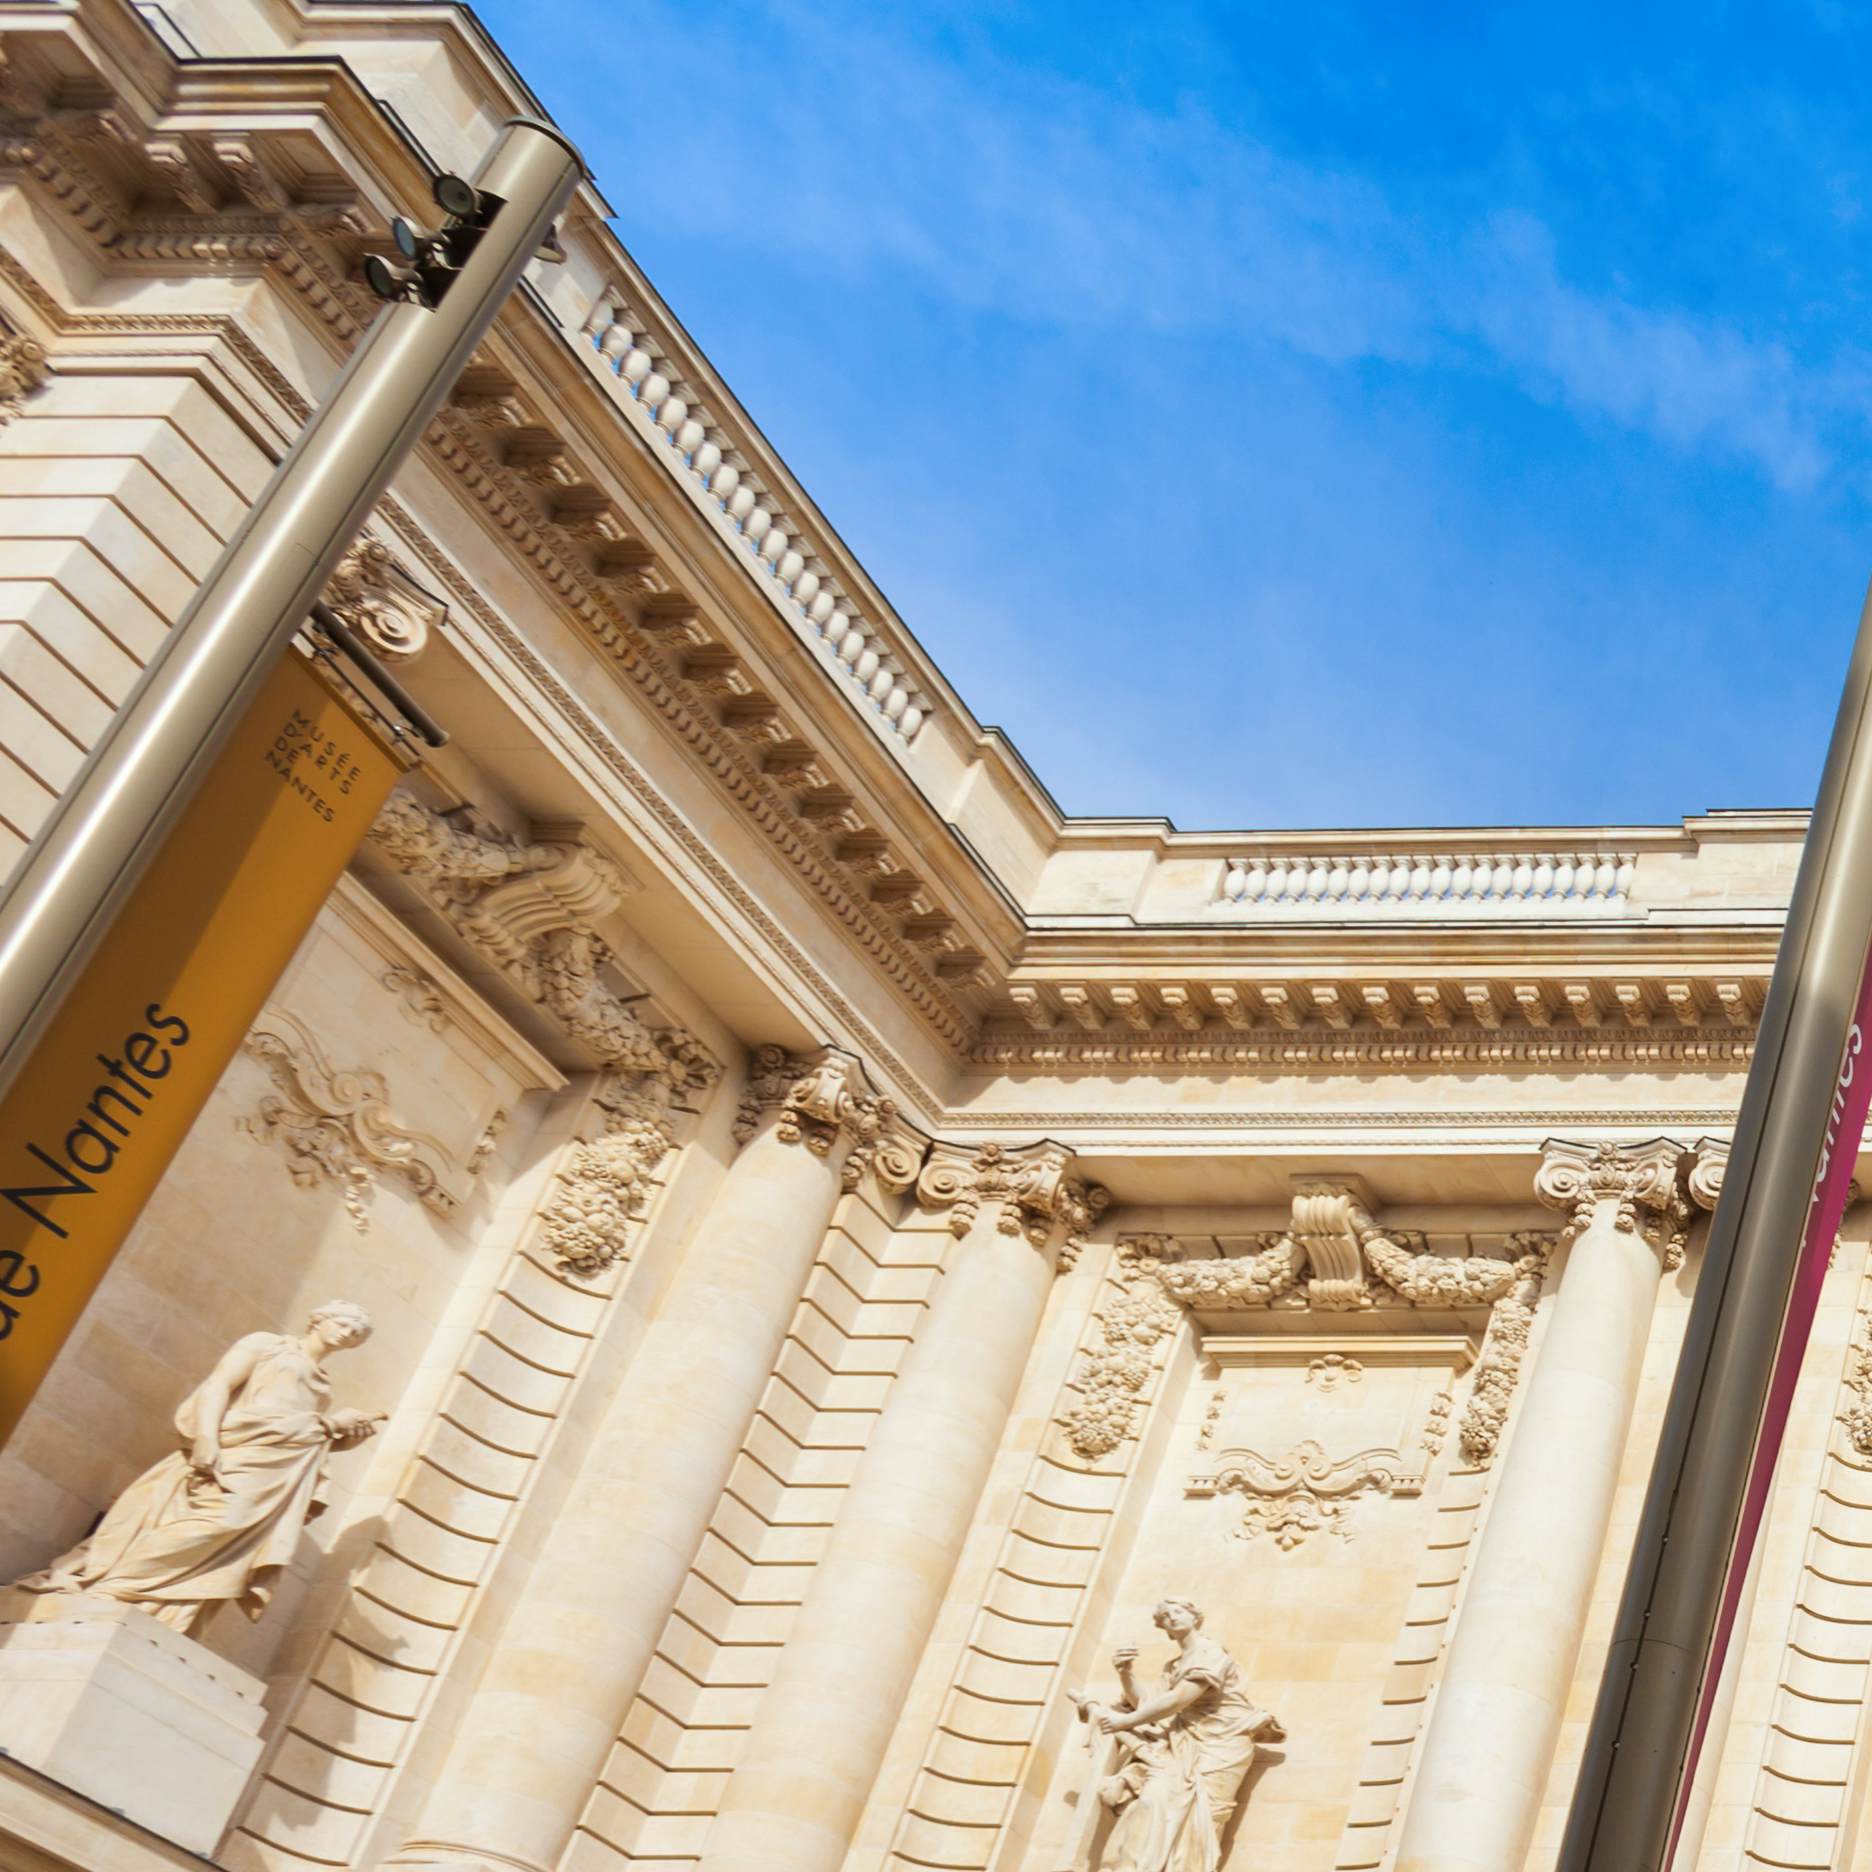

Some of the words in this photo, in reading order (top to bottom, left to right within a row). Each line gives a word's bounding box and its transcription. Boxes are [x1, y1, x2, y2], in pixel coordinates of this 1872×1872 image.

[265, 750, 335, 823] NANTES
[274, 736, 300, 764] DE
[0, 1003, 190, 1240] Nantes
